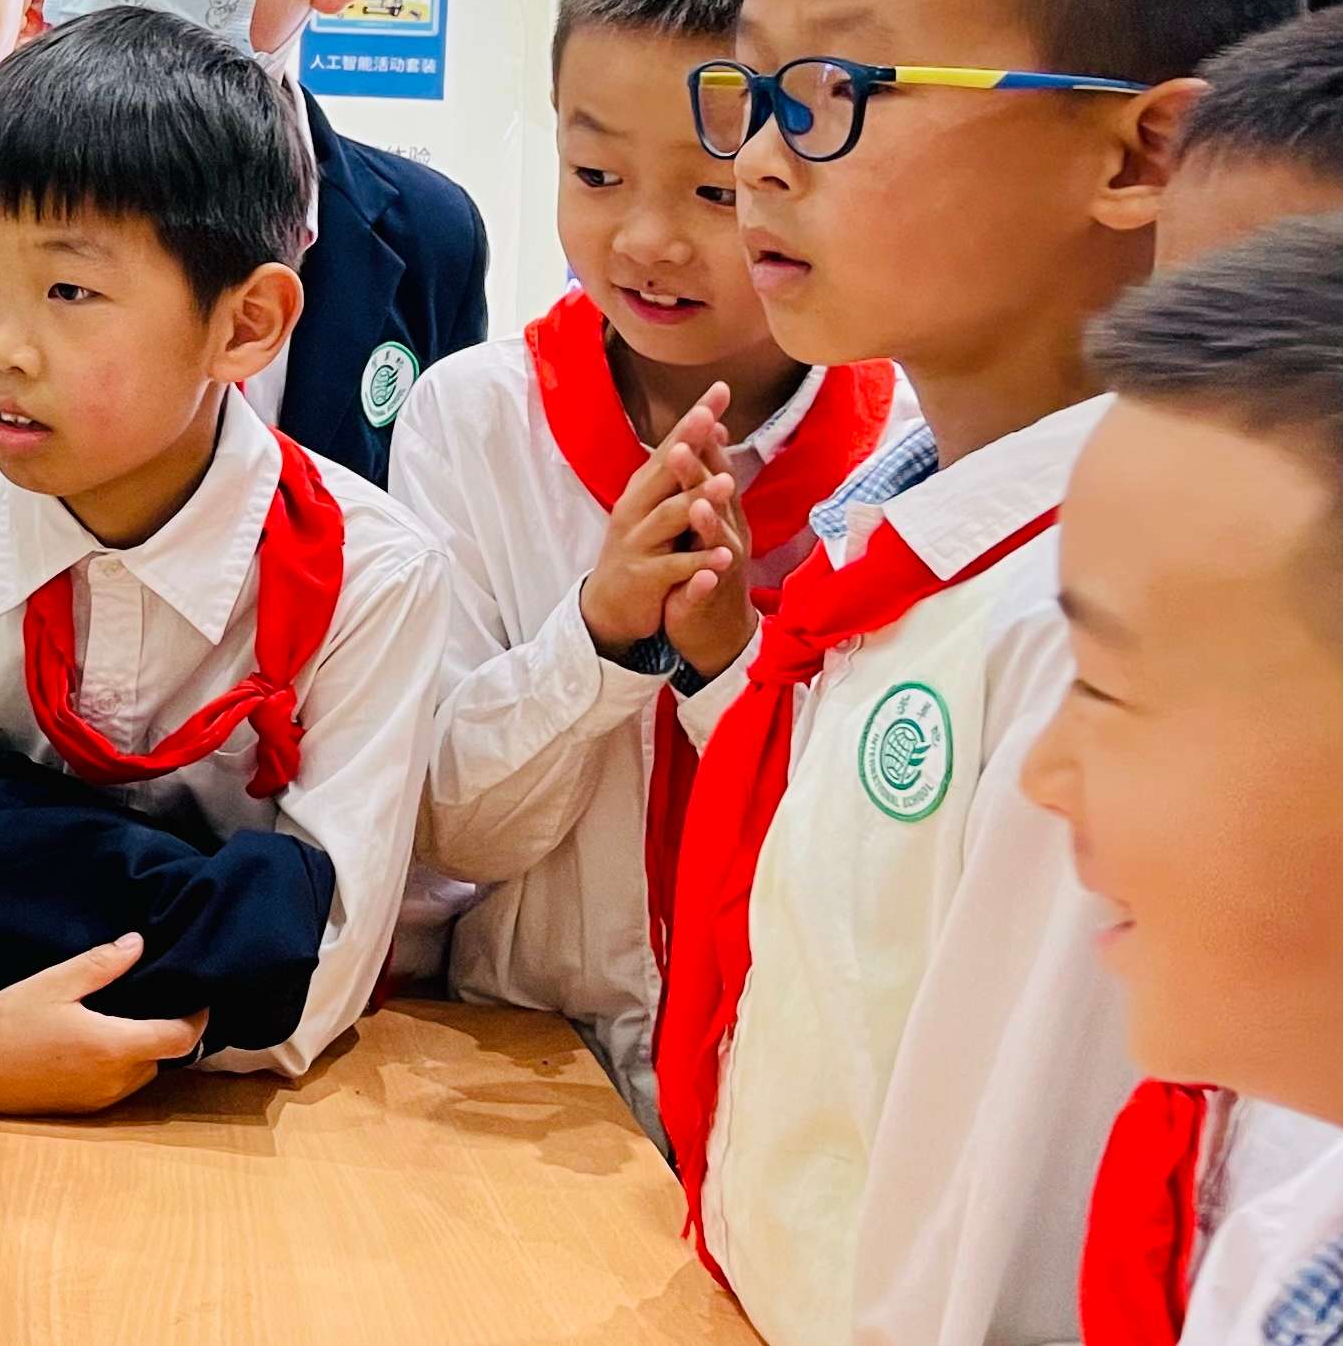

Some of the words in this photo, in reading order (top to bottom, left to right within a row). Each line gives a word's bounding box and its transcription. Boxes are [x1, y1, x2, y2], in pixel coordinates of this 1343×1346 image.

[310, 53, 437, 74] 人工智能活动套装
